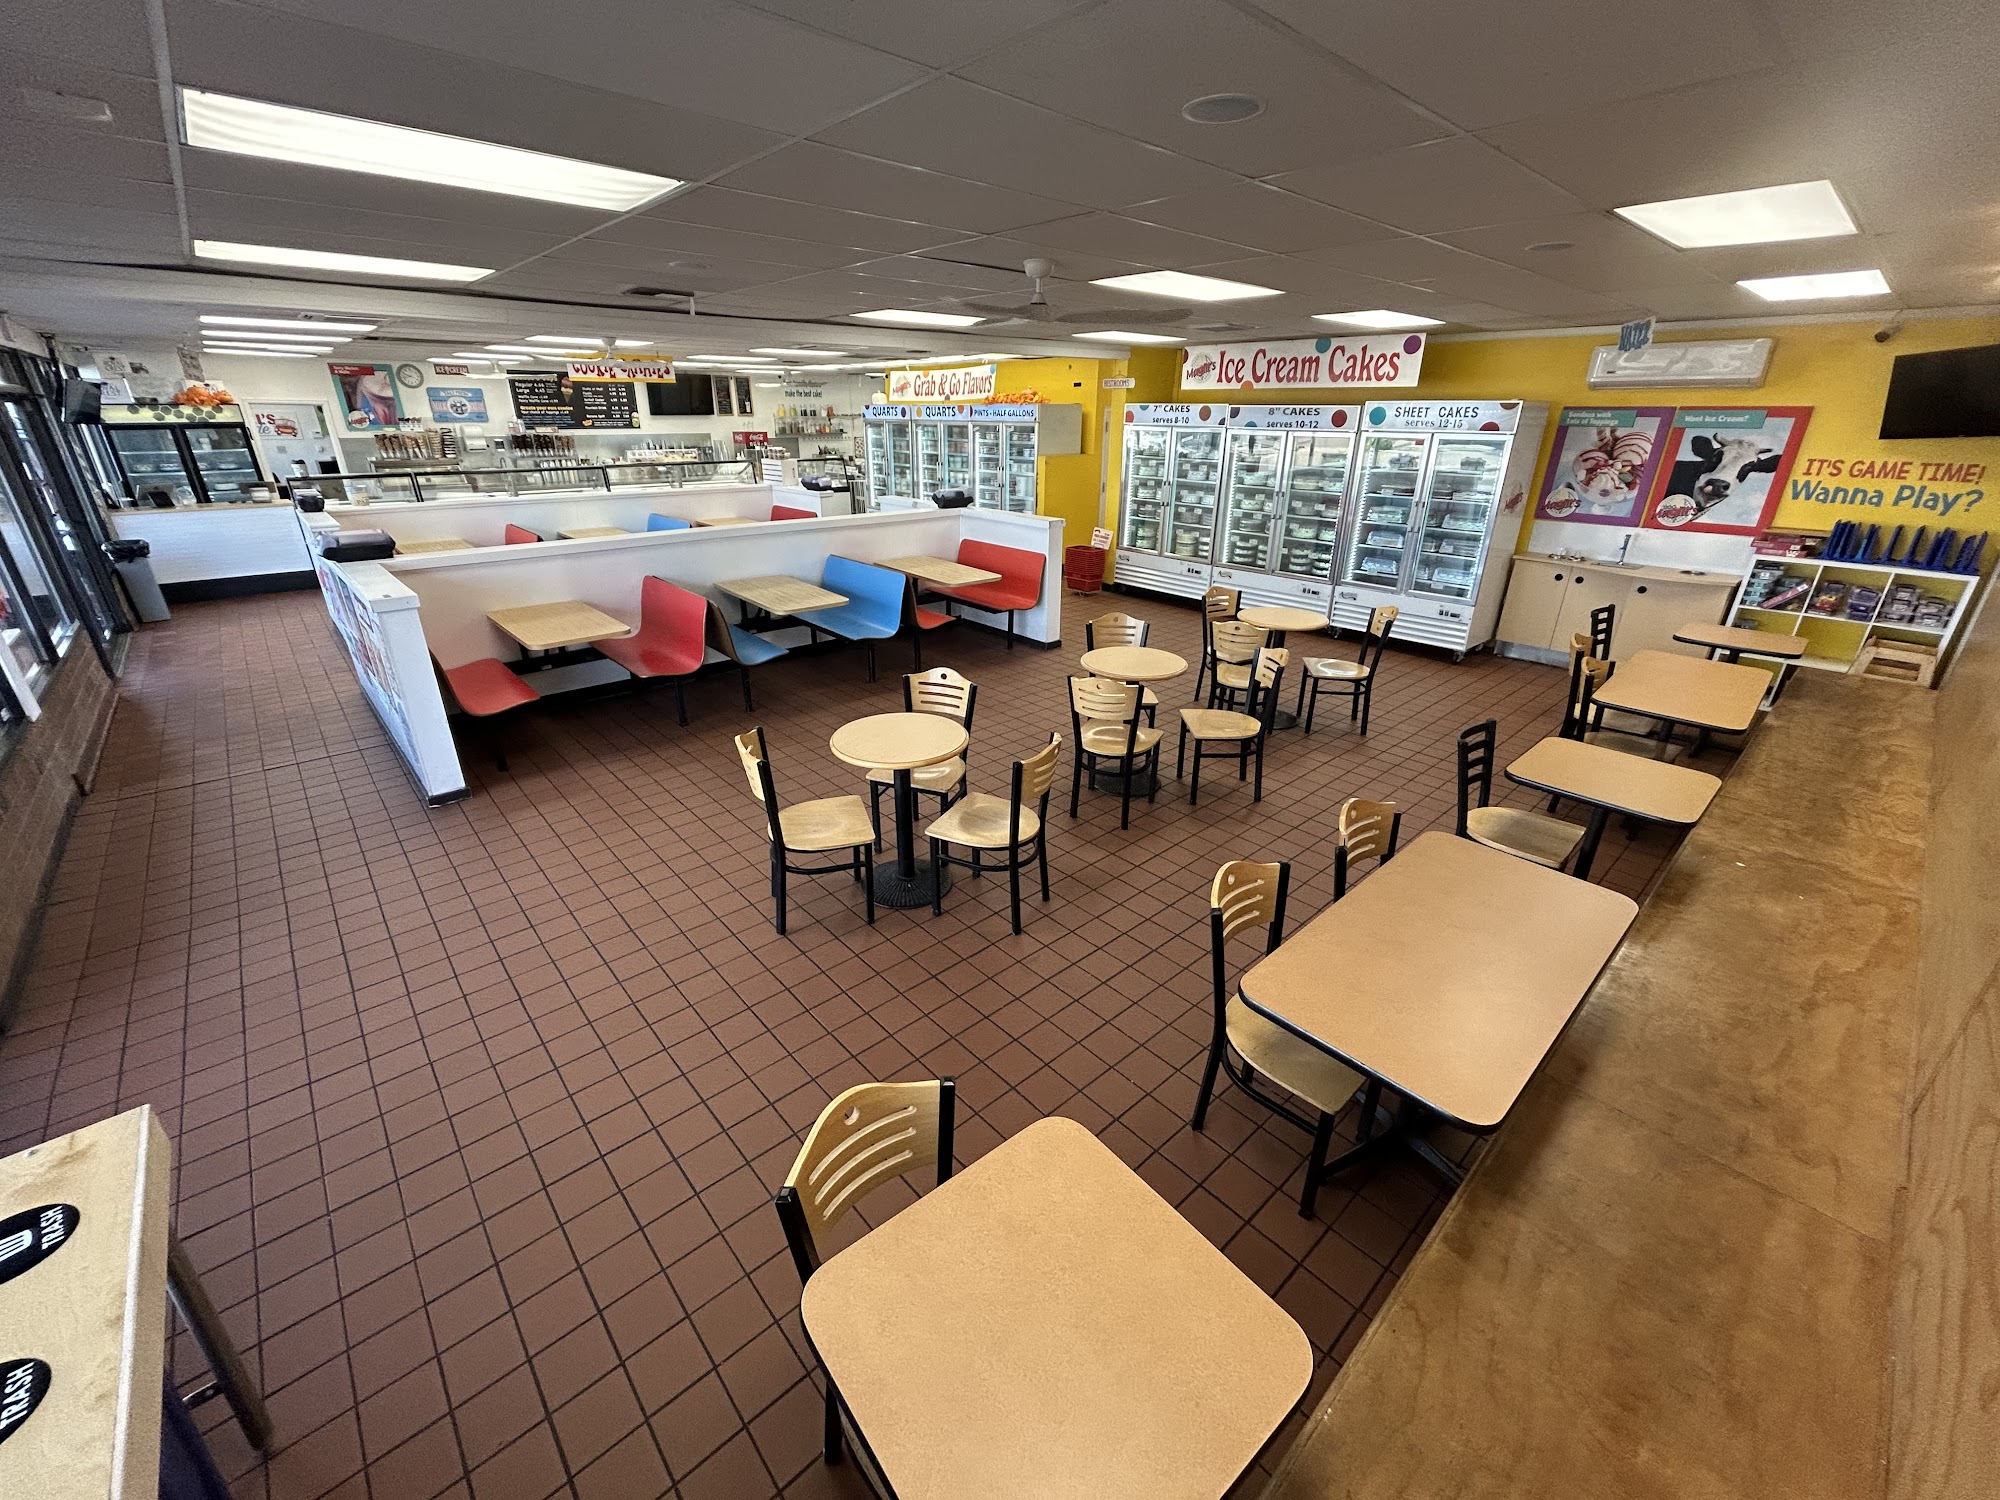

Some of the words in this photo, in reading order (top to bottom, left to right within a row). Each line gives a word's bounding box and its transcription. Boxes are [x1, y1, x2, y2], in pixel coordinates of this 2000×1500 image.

[1216, 350, 1246, 383] Ice
[1251, 348, 1321, 383] Cream
[1327, 344, 1401, 382] Cakes
[435, 365, 446, 374] ICE
[913, 374, 936, 397] Grab
[938, 373, 948, 396] &
[949, 372, 960, 396] Go
[962, 371, 993, 395] Flavors
[1103, 379, 1130, 388] RESTROOMS
[872, 406, 898, 416] QUARTS
[925, 406, 956, 417] QUARTS
[974, 409, 989, 417] PINTS
[1008, 409, 1034, 418] GALLONS
[1164, 405, 1191, 413] CAKES
[1268, 408, 1280, 416] 8"
[1282, 407, 1321, 416] CAKES
[1394, 406, 1430, 418] SHEET
[1438, 406, 1479, 418] CAKES
[1174, 416, 1190, 425] 8-10
[1404, 419, 1435, 428] serves
[1438, 419, 1463, 429] 12-15
[1718, 415, 1749, 423] Cream?
[1266, 421, 1293, 429] serves
[1294, 420, 1319, 429] 10-12
[1802, 458, 1845, 477] IT'S
[1849, 460, 1913, 480] GAME
[1919, 461, 1986, 485] TIME!
[1791, 479, 1884, 508] Wanna
[1892, 485, 1985, 516] Play?
[40, 1205, 65, 1250] TRASH
[0, 1362, 34, 1430] TRASH
